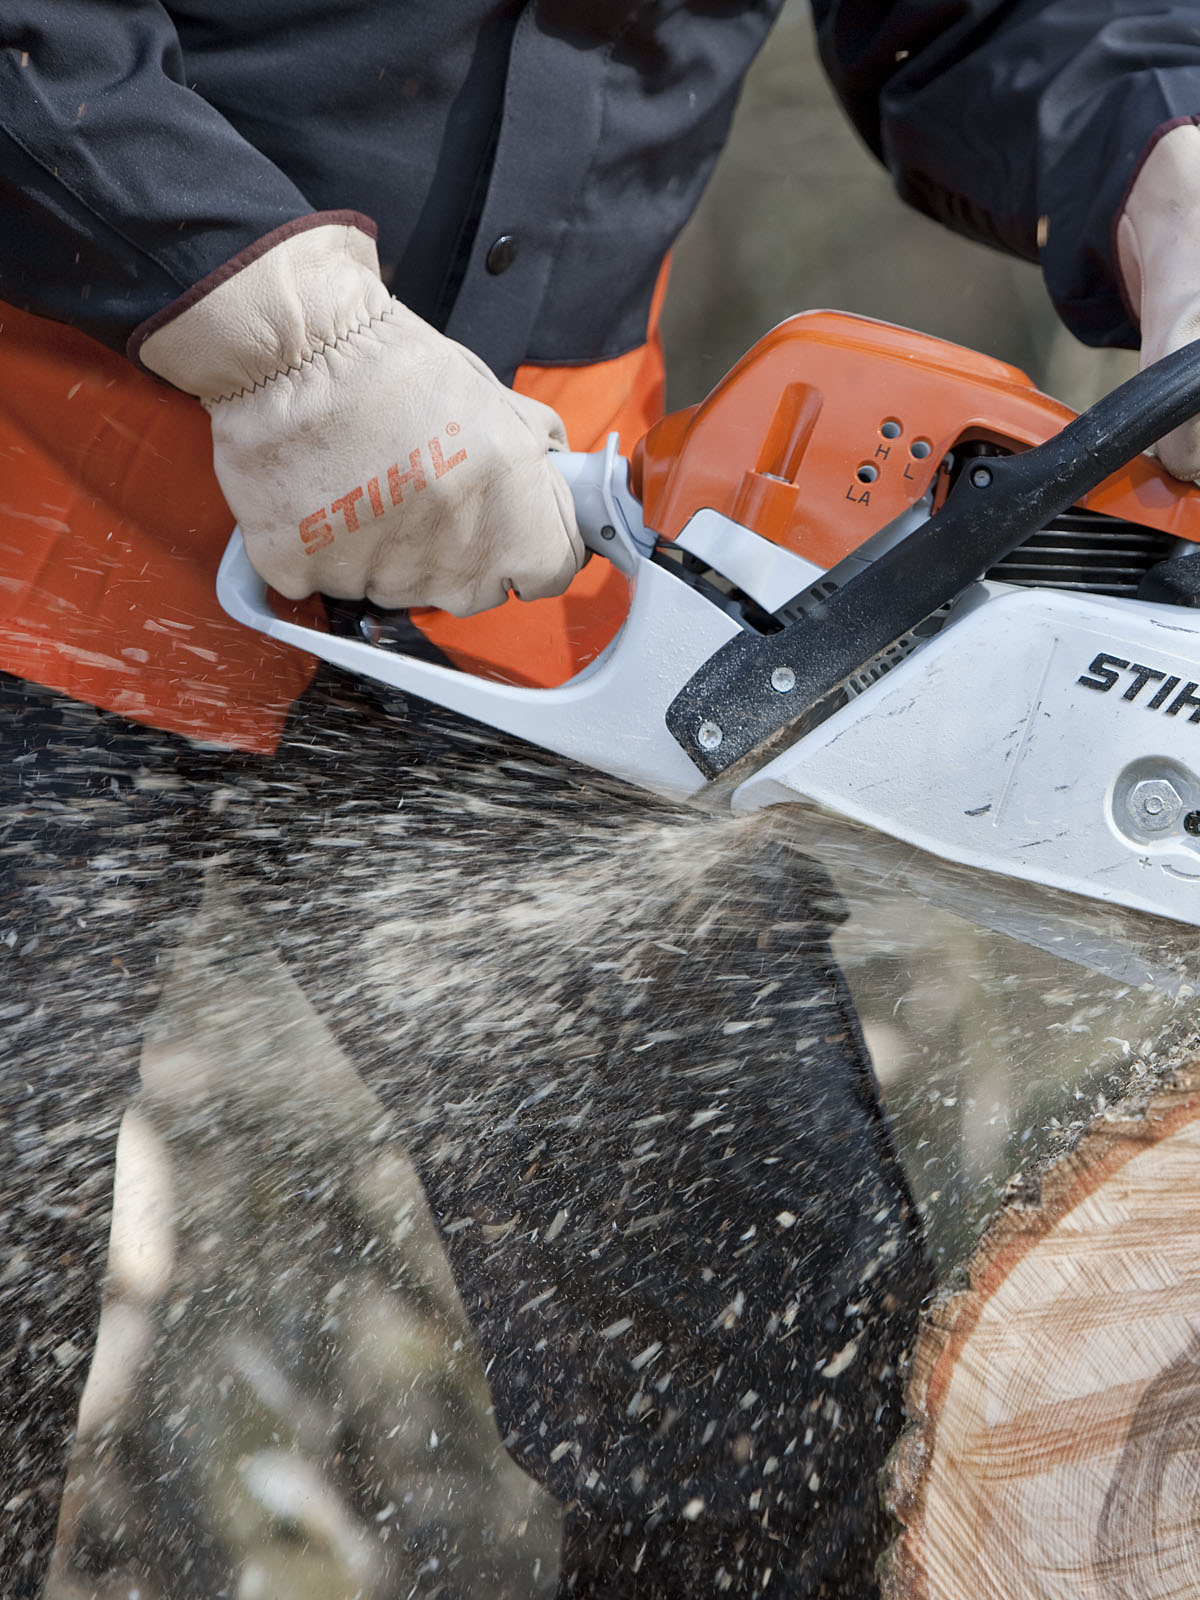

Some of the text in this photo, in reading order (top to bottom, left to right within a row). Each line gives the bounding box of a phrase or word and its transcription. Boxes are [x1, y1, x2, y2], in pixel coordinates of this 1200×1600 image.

[875, 444, 891, 460] H
[903, 463, 914, 480] L
[845, 485, 872, 507] LA
